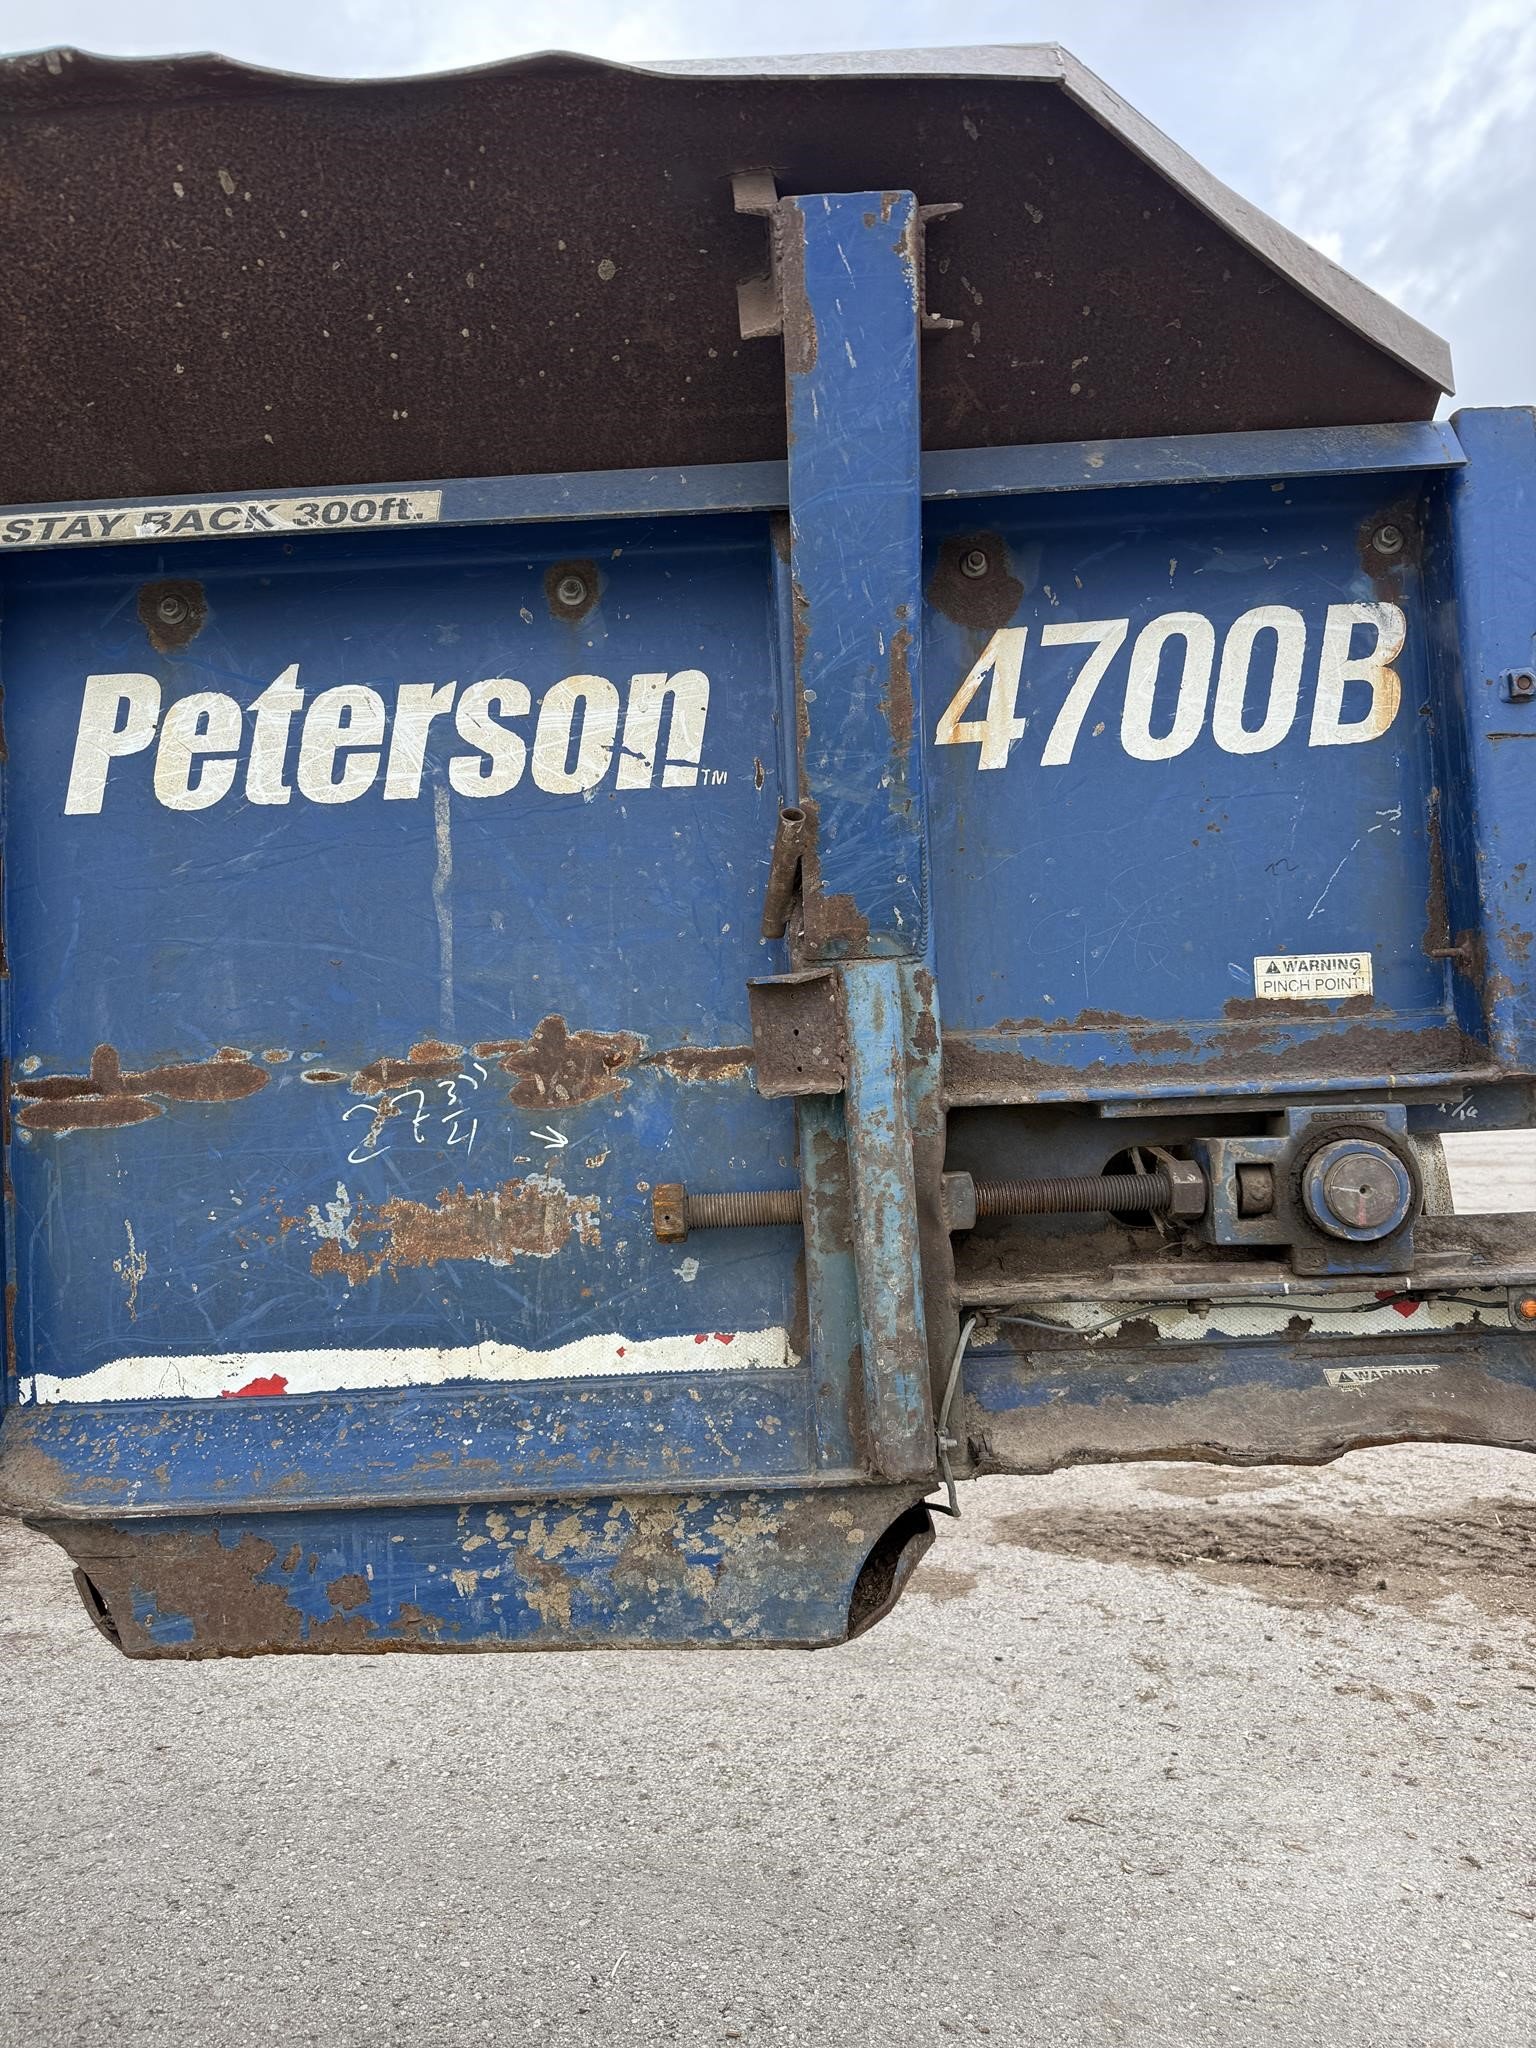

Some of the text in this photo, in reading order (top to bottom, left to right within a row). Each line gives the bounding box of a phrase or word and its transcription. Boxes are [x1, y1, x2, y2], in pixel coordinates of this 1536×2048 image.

[1, 497, 424, 544] STAY BACK 300ft.
[934, 601, 1407, 771] 4700B
[63, 664, 728, 815] Peterson TM
[1263, 976, 1365, 993] PINCH POINT!
[1282, 957, 1361, 974] WARNING
